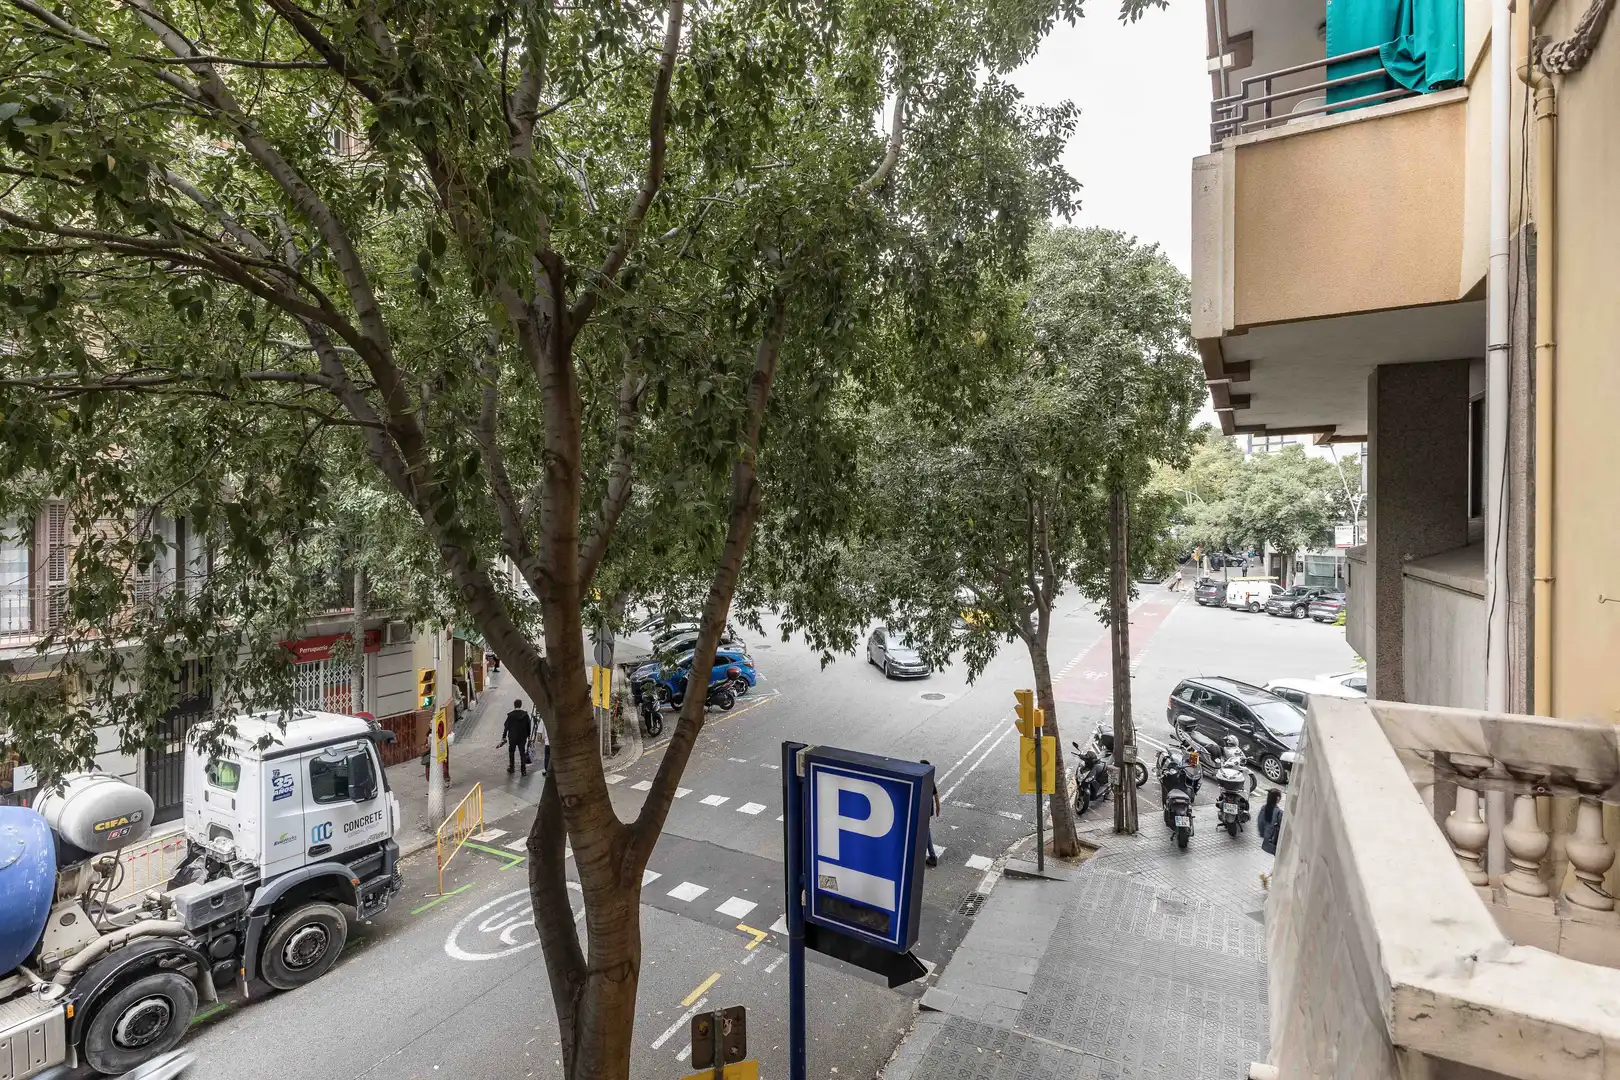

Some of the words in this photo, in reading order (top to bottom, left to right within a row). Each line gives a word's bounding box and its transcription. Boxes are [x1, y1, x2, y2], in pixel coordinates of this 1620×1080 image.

[300, 644, 328, 654] Perruqueria
[273, 775, 293, 789] 35
[343, 809, 383, 833] CONCRETE
[817, 771, 895, 860] P
[95, 817, 129, 831] CIFA
